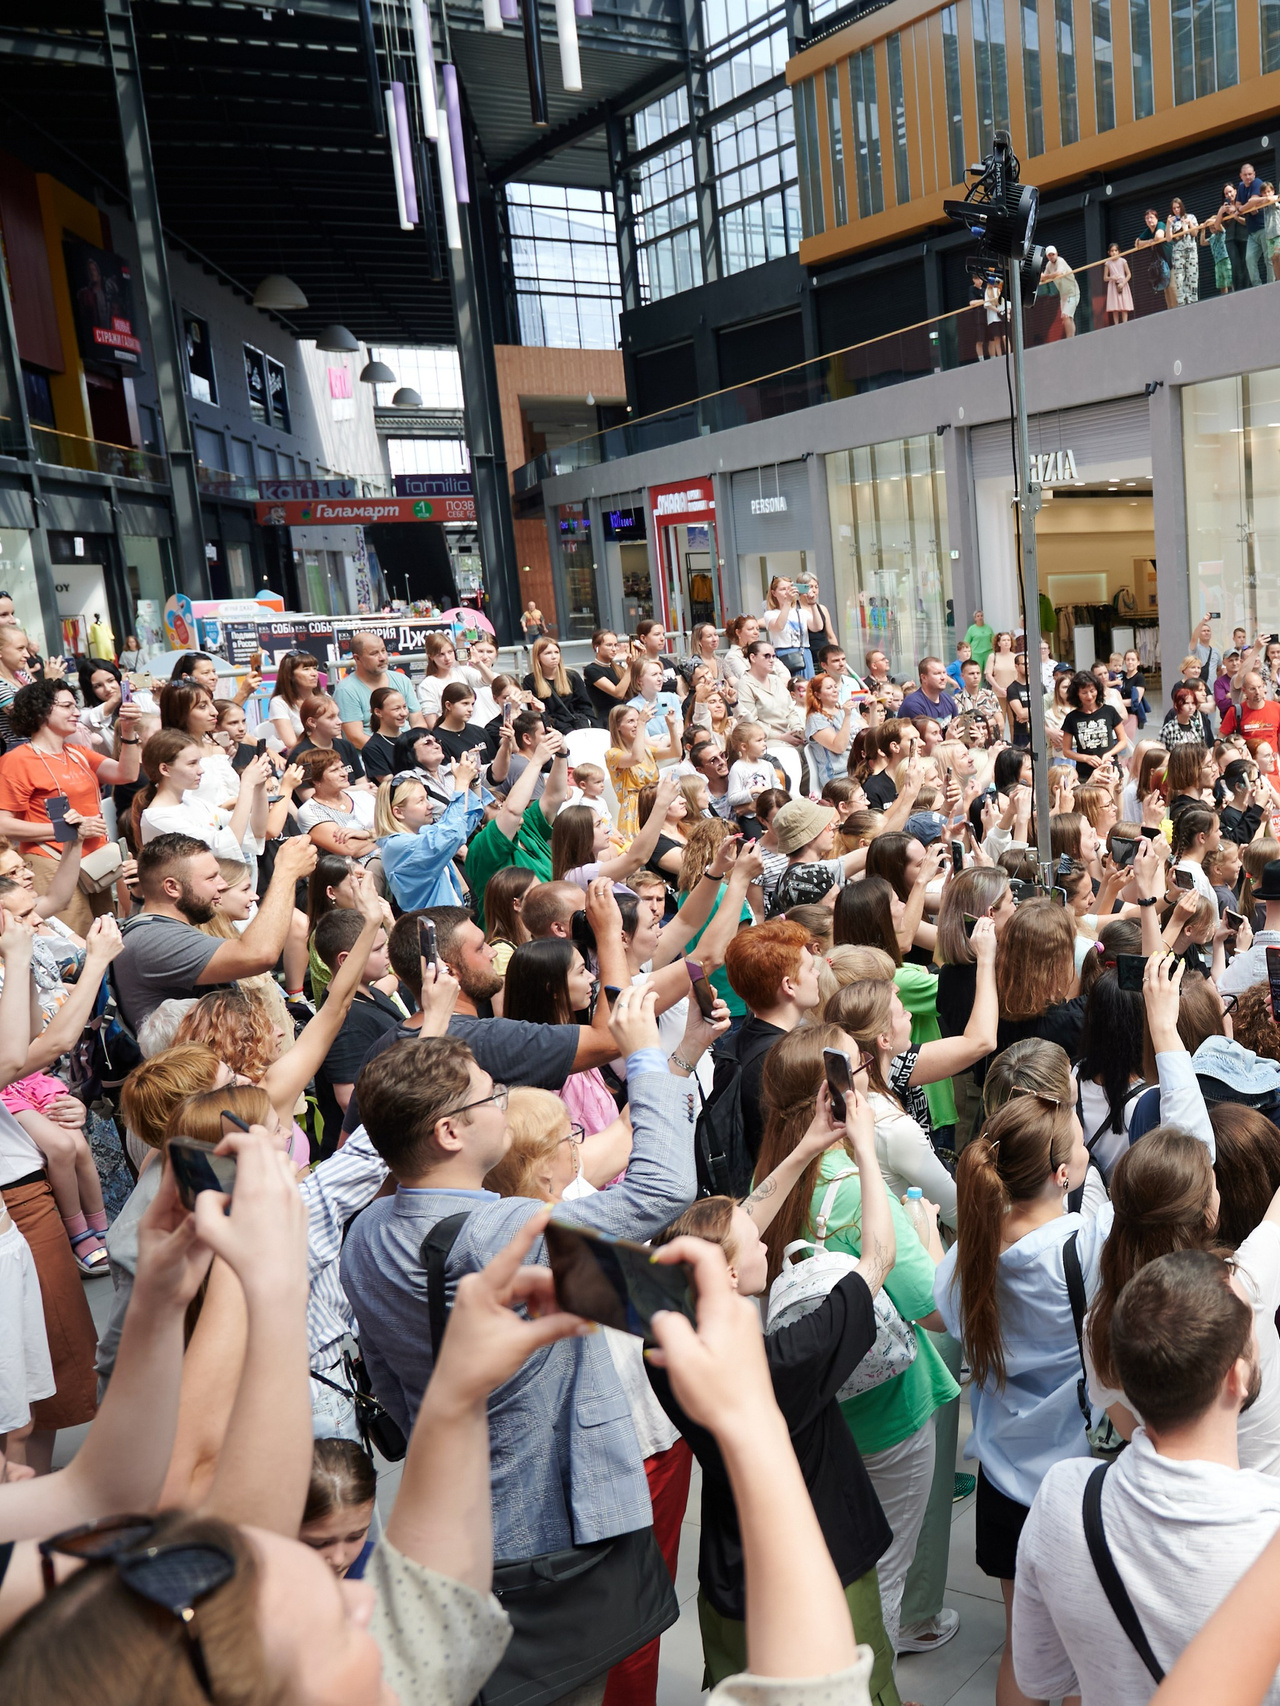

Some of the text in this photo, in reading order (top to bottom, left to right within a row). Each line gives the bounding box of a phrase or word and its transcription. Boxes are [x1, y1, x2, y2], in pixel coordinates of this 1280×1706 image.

[261, 482, 313, 499] kari
[405, 478, 471, 494] familia
[316, 504, 399, 520] Галамарт
[446, 500, 475, 511] ПОЗВ
[751, 497, 787, 514] PERSONA
[448, 510, 465, 518] СЕБЕ
[897, 1052, 918, 1087] RULES
